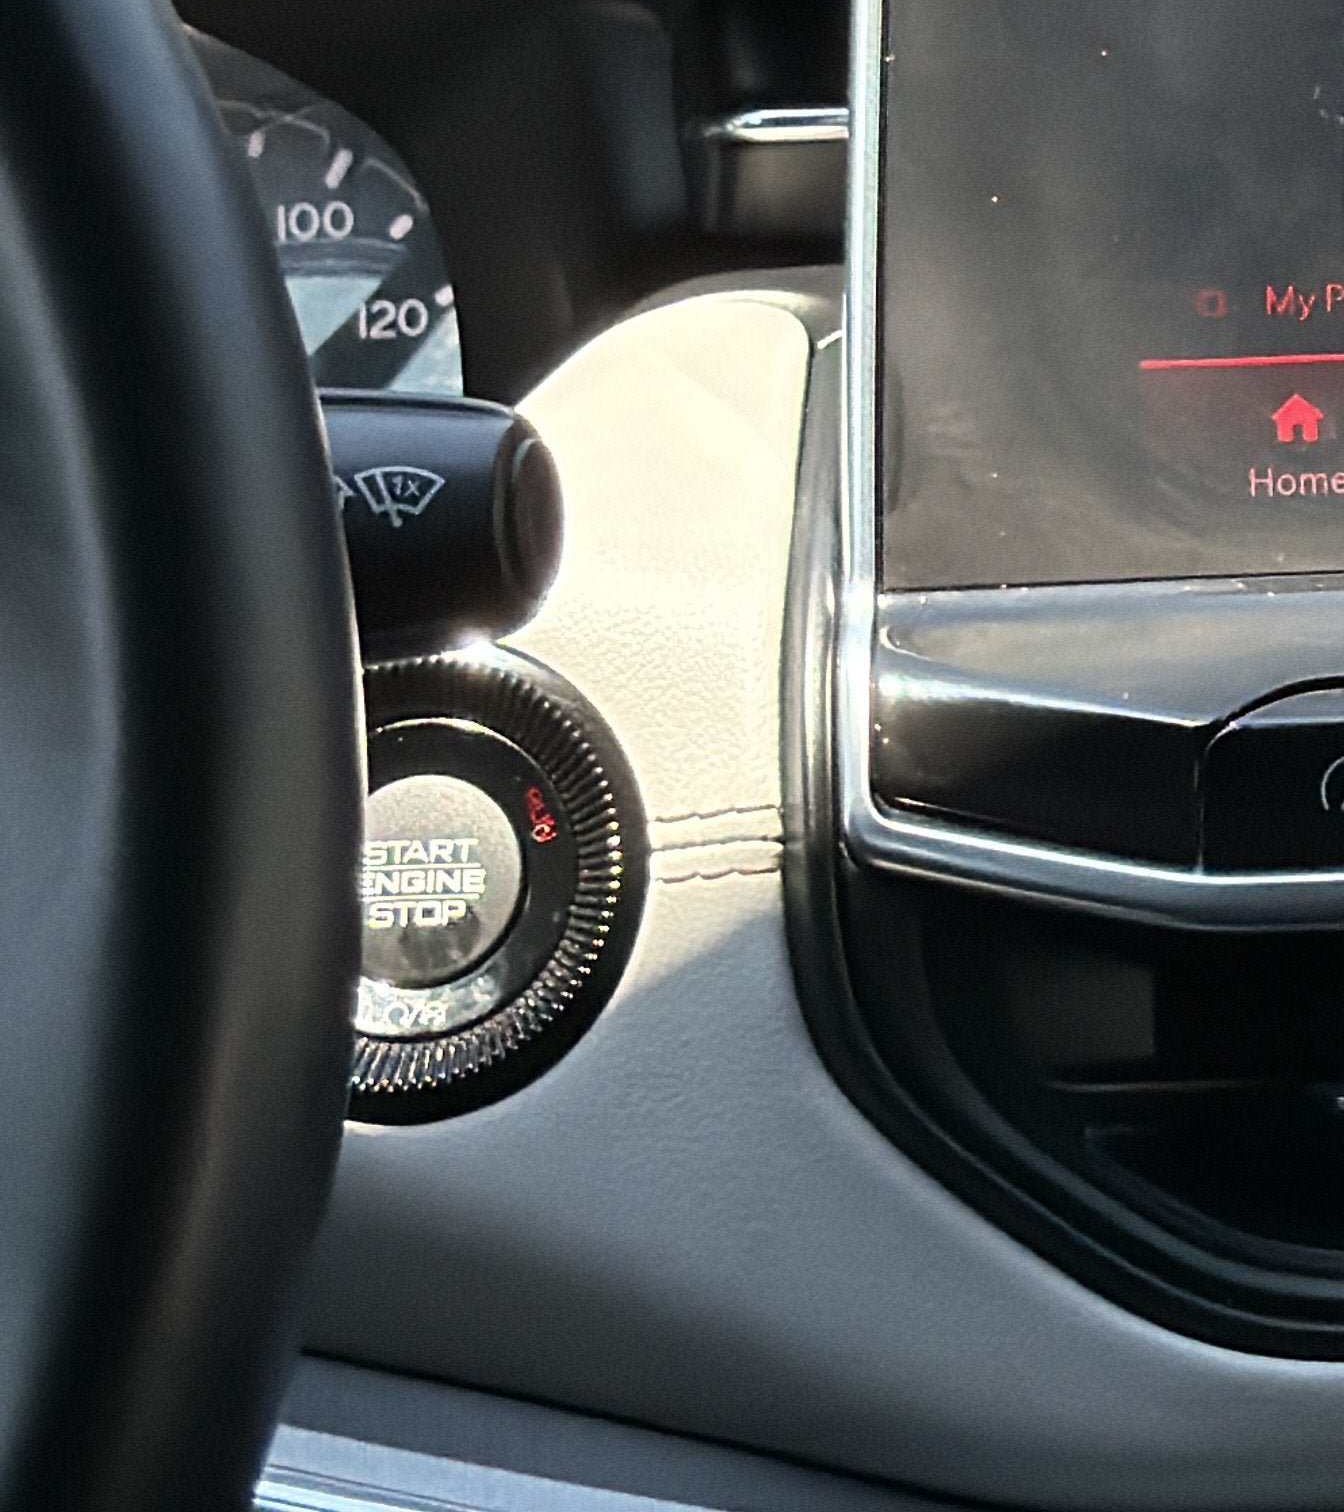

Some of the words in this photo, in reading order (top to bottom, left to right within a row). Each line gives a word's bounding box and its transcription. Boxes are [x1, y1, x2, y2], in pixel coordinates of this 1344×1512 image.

[276, 201, 354, 241] 100
[1267, 286, 1315, 320] My
[358, 298, 428, 340] 120
[363, 838, 479, 865] START
[362, 869, 487, 894] ENGINE
[368, 900, 466, 929] STOP
